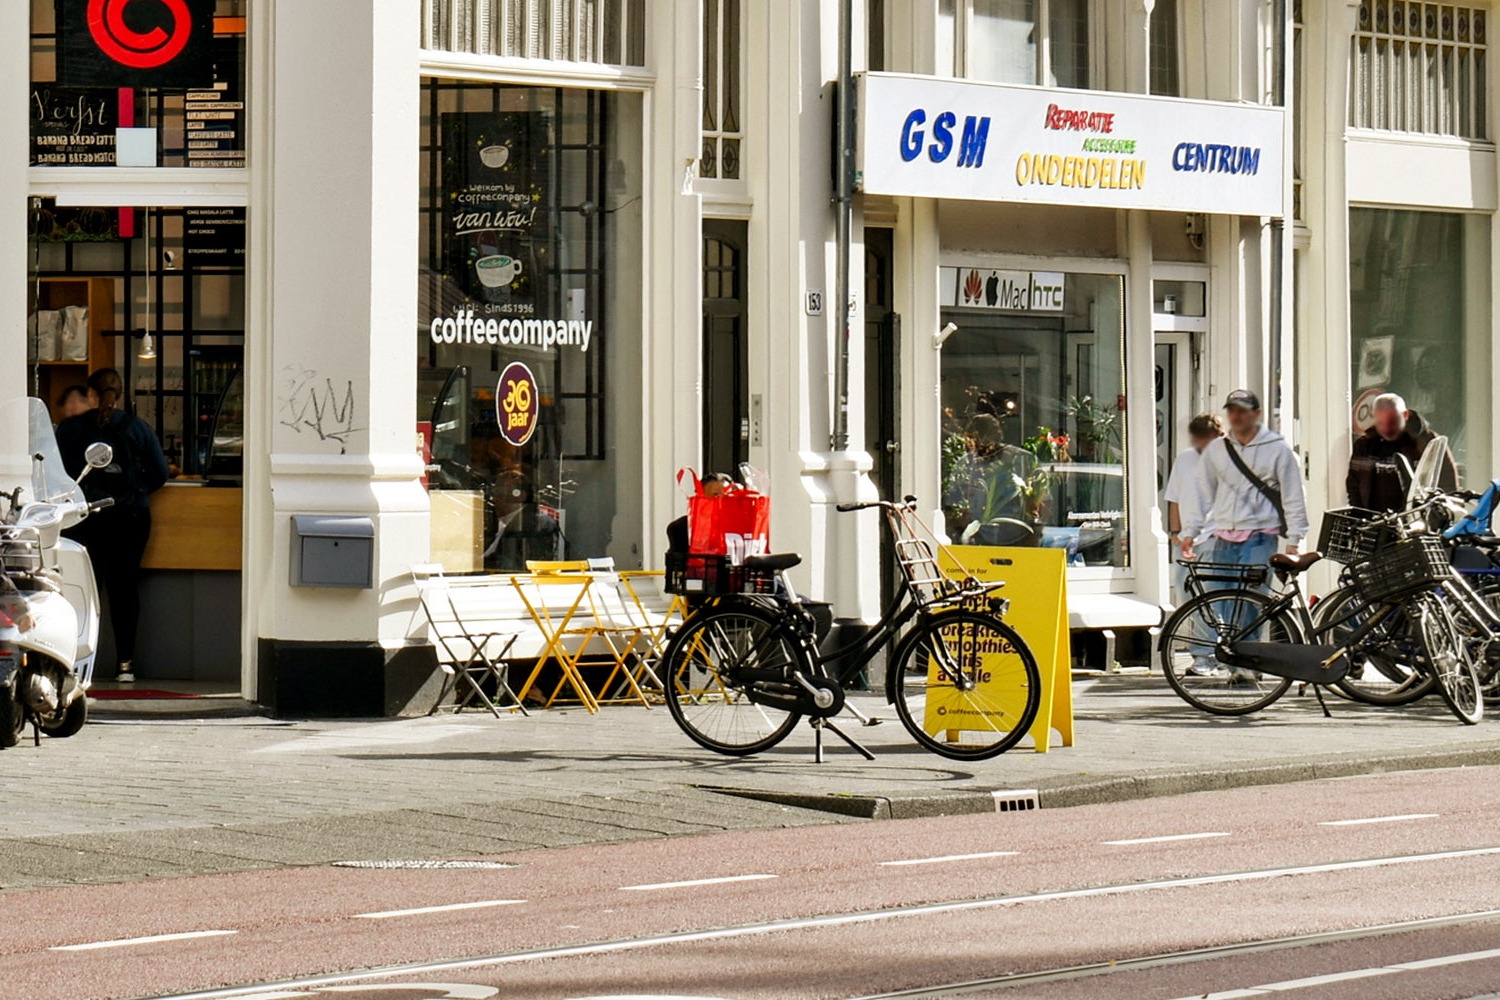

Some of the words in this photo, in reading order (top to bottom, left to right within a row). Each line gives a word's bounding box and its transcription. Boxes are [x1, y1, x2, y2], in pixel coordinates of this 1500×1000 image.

[1044, 103, 1115, 133] REPARATIE
[900, 108, 991, 168] GSM
[94, 152, 116, 163] MATCH
[1016, 152, 1146, 189] ONDERDELEN
[1172, 142, 1261, 176] CENTRUM
[453, 211, 492, 230] van
[808, 292, 821, 311] 153
[1000, 279, 1027, 310] Mac
[1032, 279, 1062, 307] htc
[431, 309, 592, 352] coffeecompany
[507, 411, 529, 431] jaar
